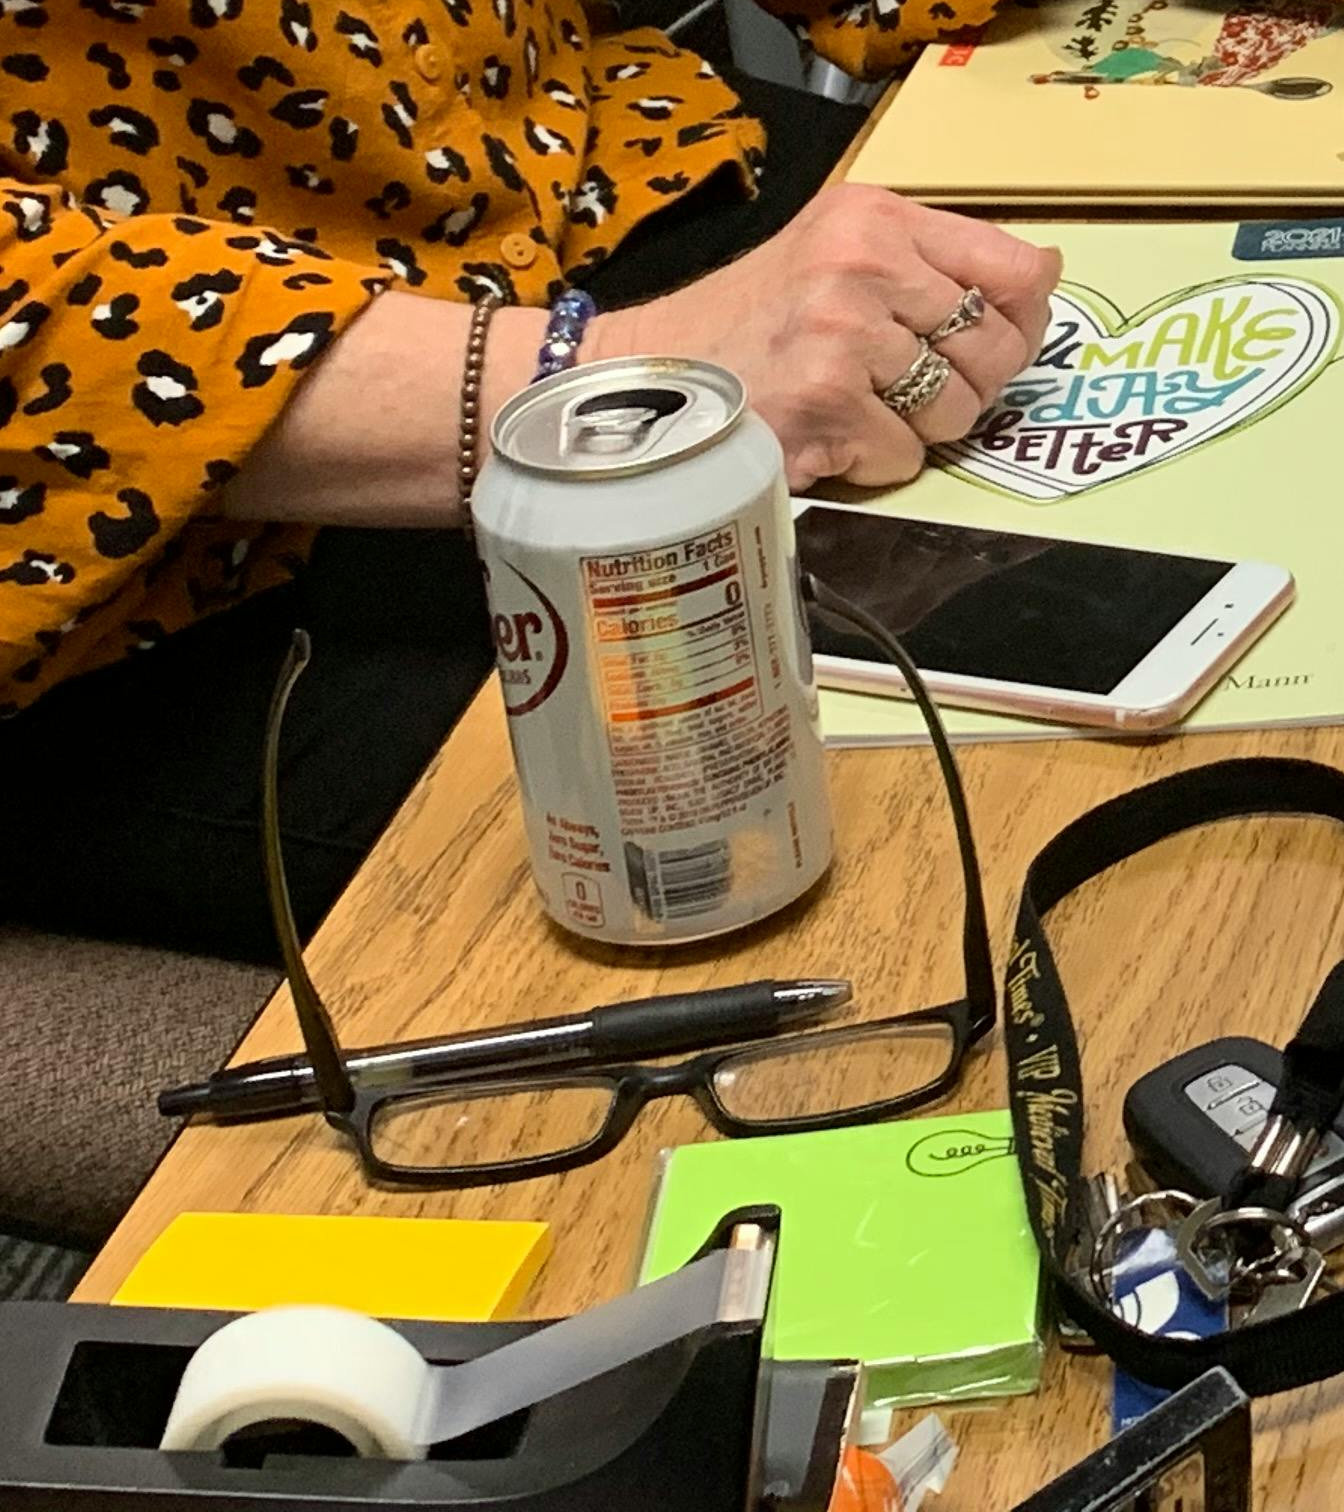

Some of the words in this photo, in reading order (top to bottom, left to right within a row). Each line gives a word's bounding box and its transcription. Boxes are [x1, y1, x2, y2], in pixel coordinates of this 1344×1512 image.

[1079, 295, 1299, 380] MAKE
[587, 551, 678, 579] Nutrition
[684, 529, 734, 562] Facts
[597, 613, 680, 635] Calories
[724, 581, 741, 606] 0
[1016, 1044, 1062, 1081] VIP
